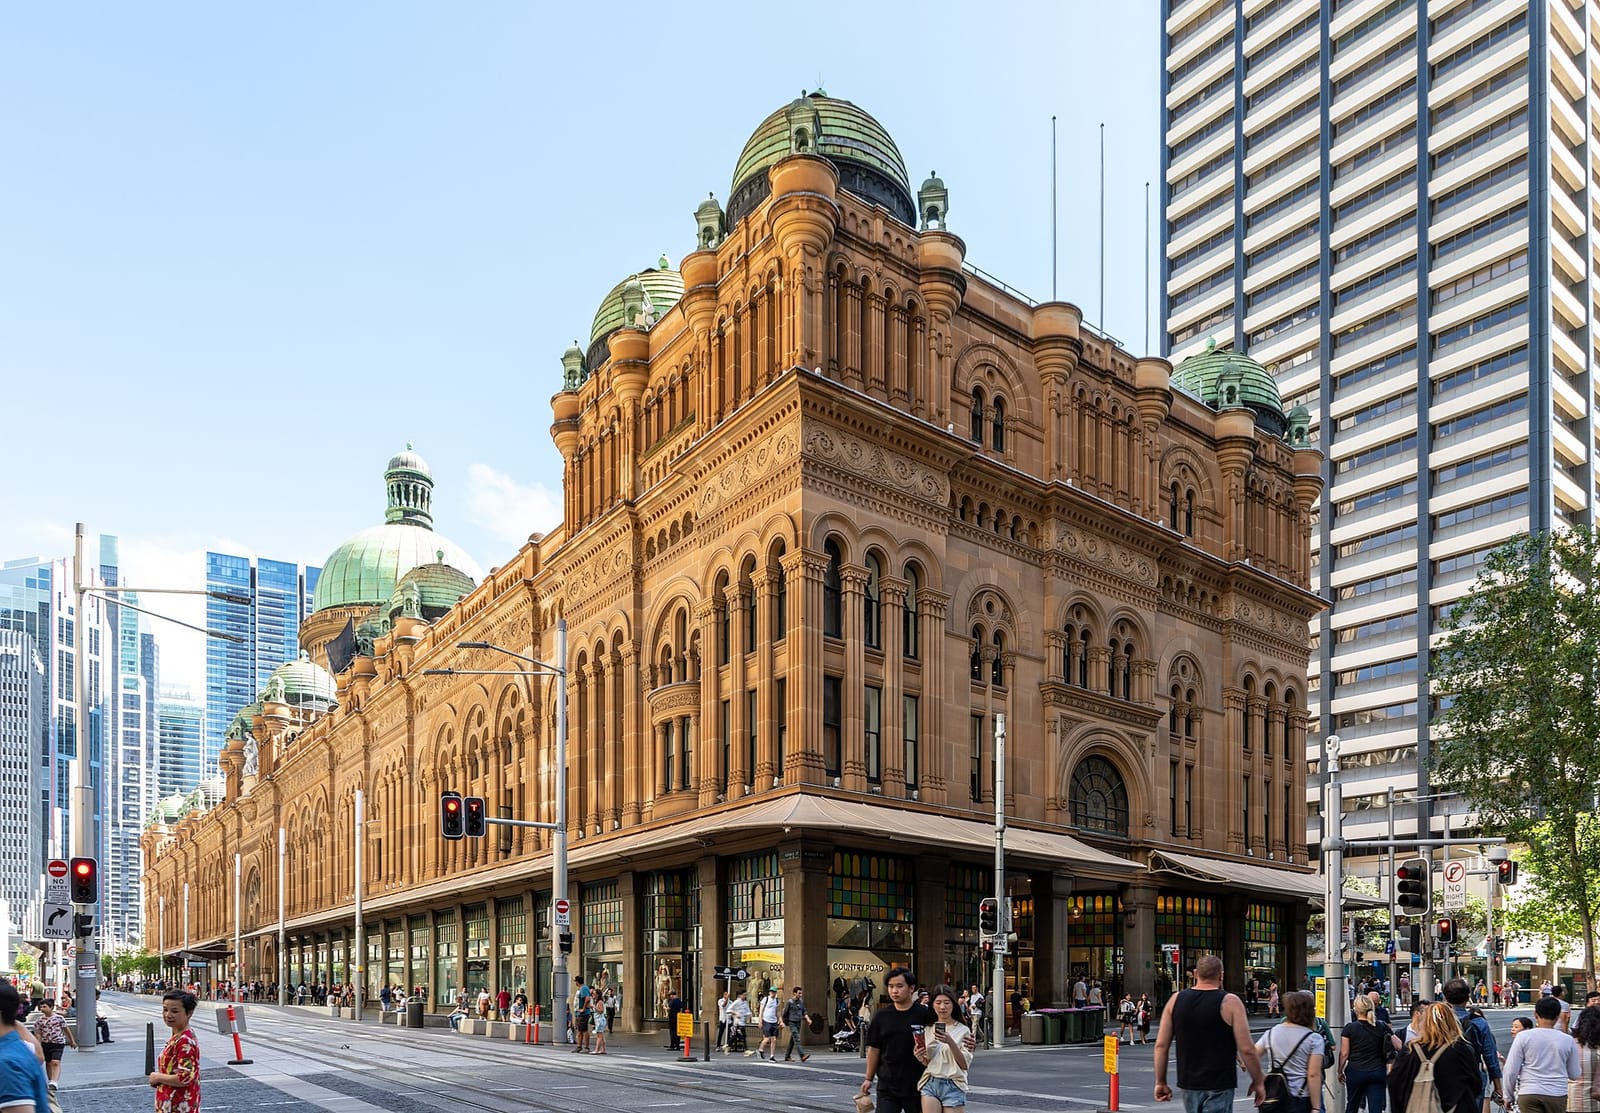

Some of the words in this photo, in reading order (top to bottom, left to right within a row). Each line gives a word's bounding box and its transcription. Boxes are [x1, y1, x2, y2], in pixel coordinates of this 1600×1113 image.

[1448, 884, 1461, 892] NO
[45, 928, 70, 936] ONLY
[832, 962, 865, 972] COUNTRY
[865, 964, 884, 973] ROAD
